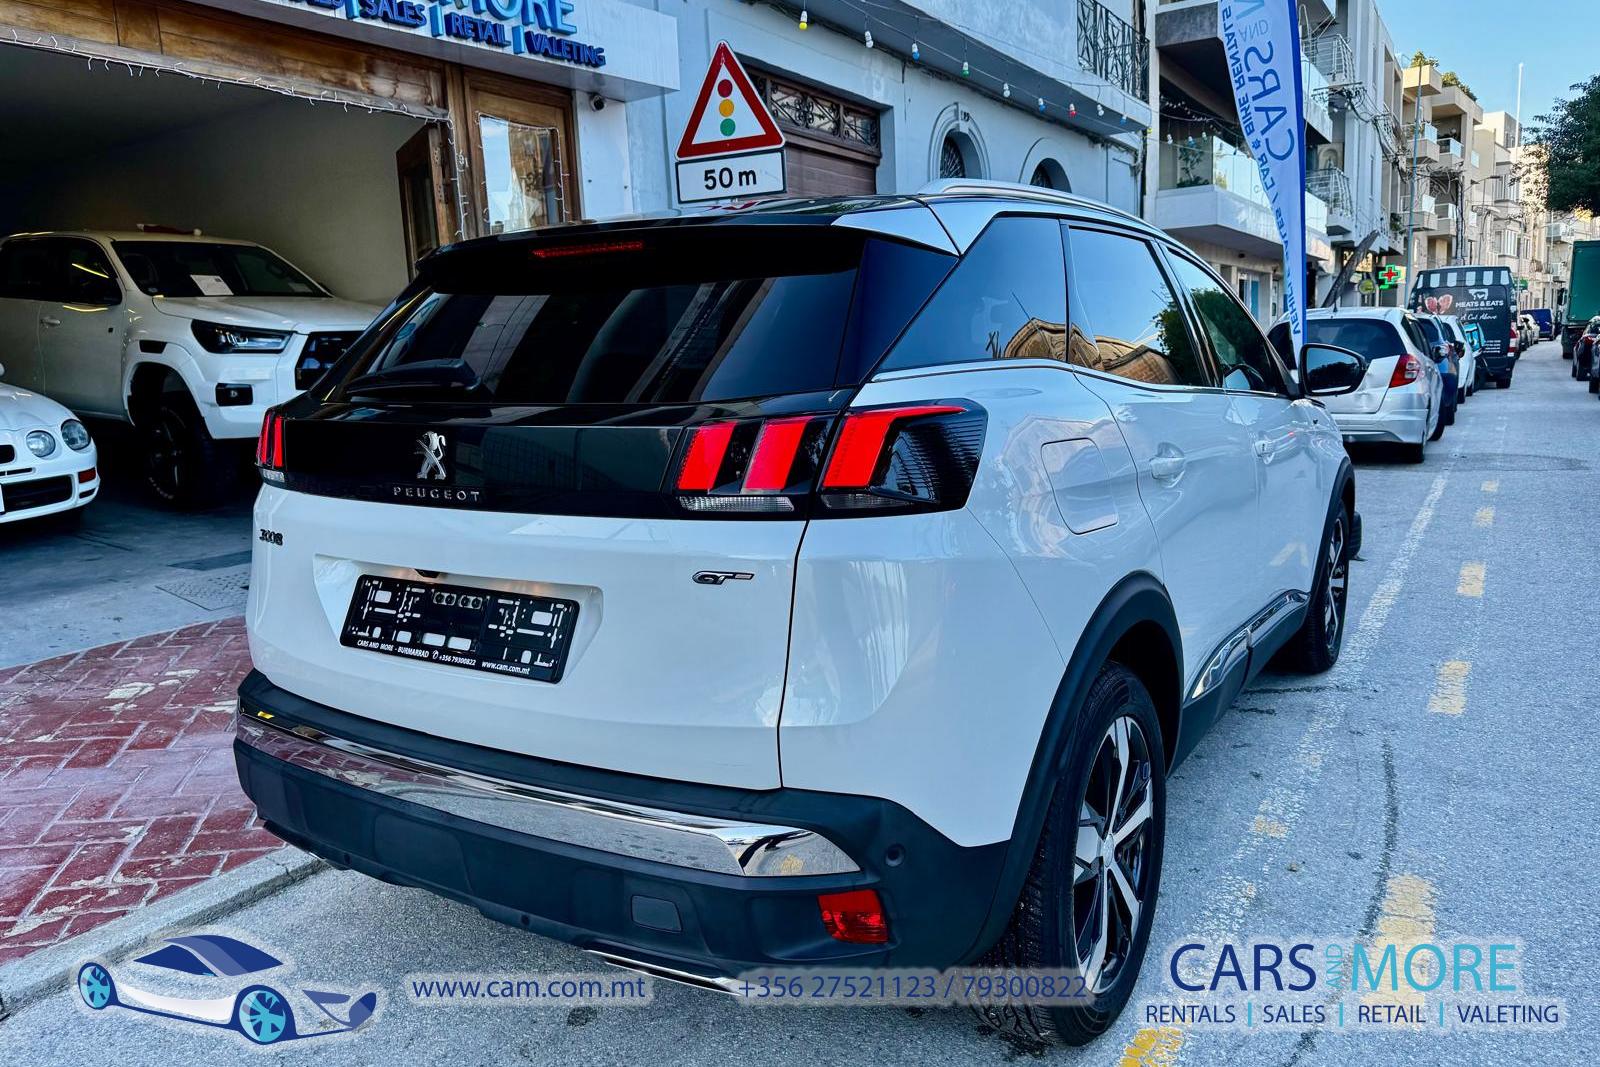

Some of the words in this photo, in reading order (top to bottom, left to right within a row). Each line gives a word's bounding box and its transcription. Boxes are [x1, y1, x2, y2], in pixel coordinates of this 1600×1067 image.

[438, 0, 577, 35] RE
[360, 0, 427, 28] SALES
[444, 12, 511, 48] RETAIL
[525, 30, 606, 68] VALETING
[704, 167, 733, 190] 50
[738, 168, 757, 187] m
[1456, 300, 1479, 308] MEATS
[393, 486, 480, 502] PEUGEOT
[259, 529, 283, 546] 3008
[369, 641, 379, 649] AND
[380, 642, 394, 651] MORE
[439, 654, 452, 662] +356
[452, 656, 477, 666] 79300822
[481, 661, 530, 675] www.cam.com.mt
